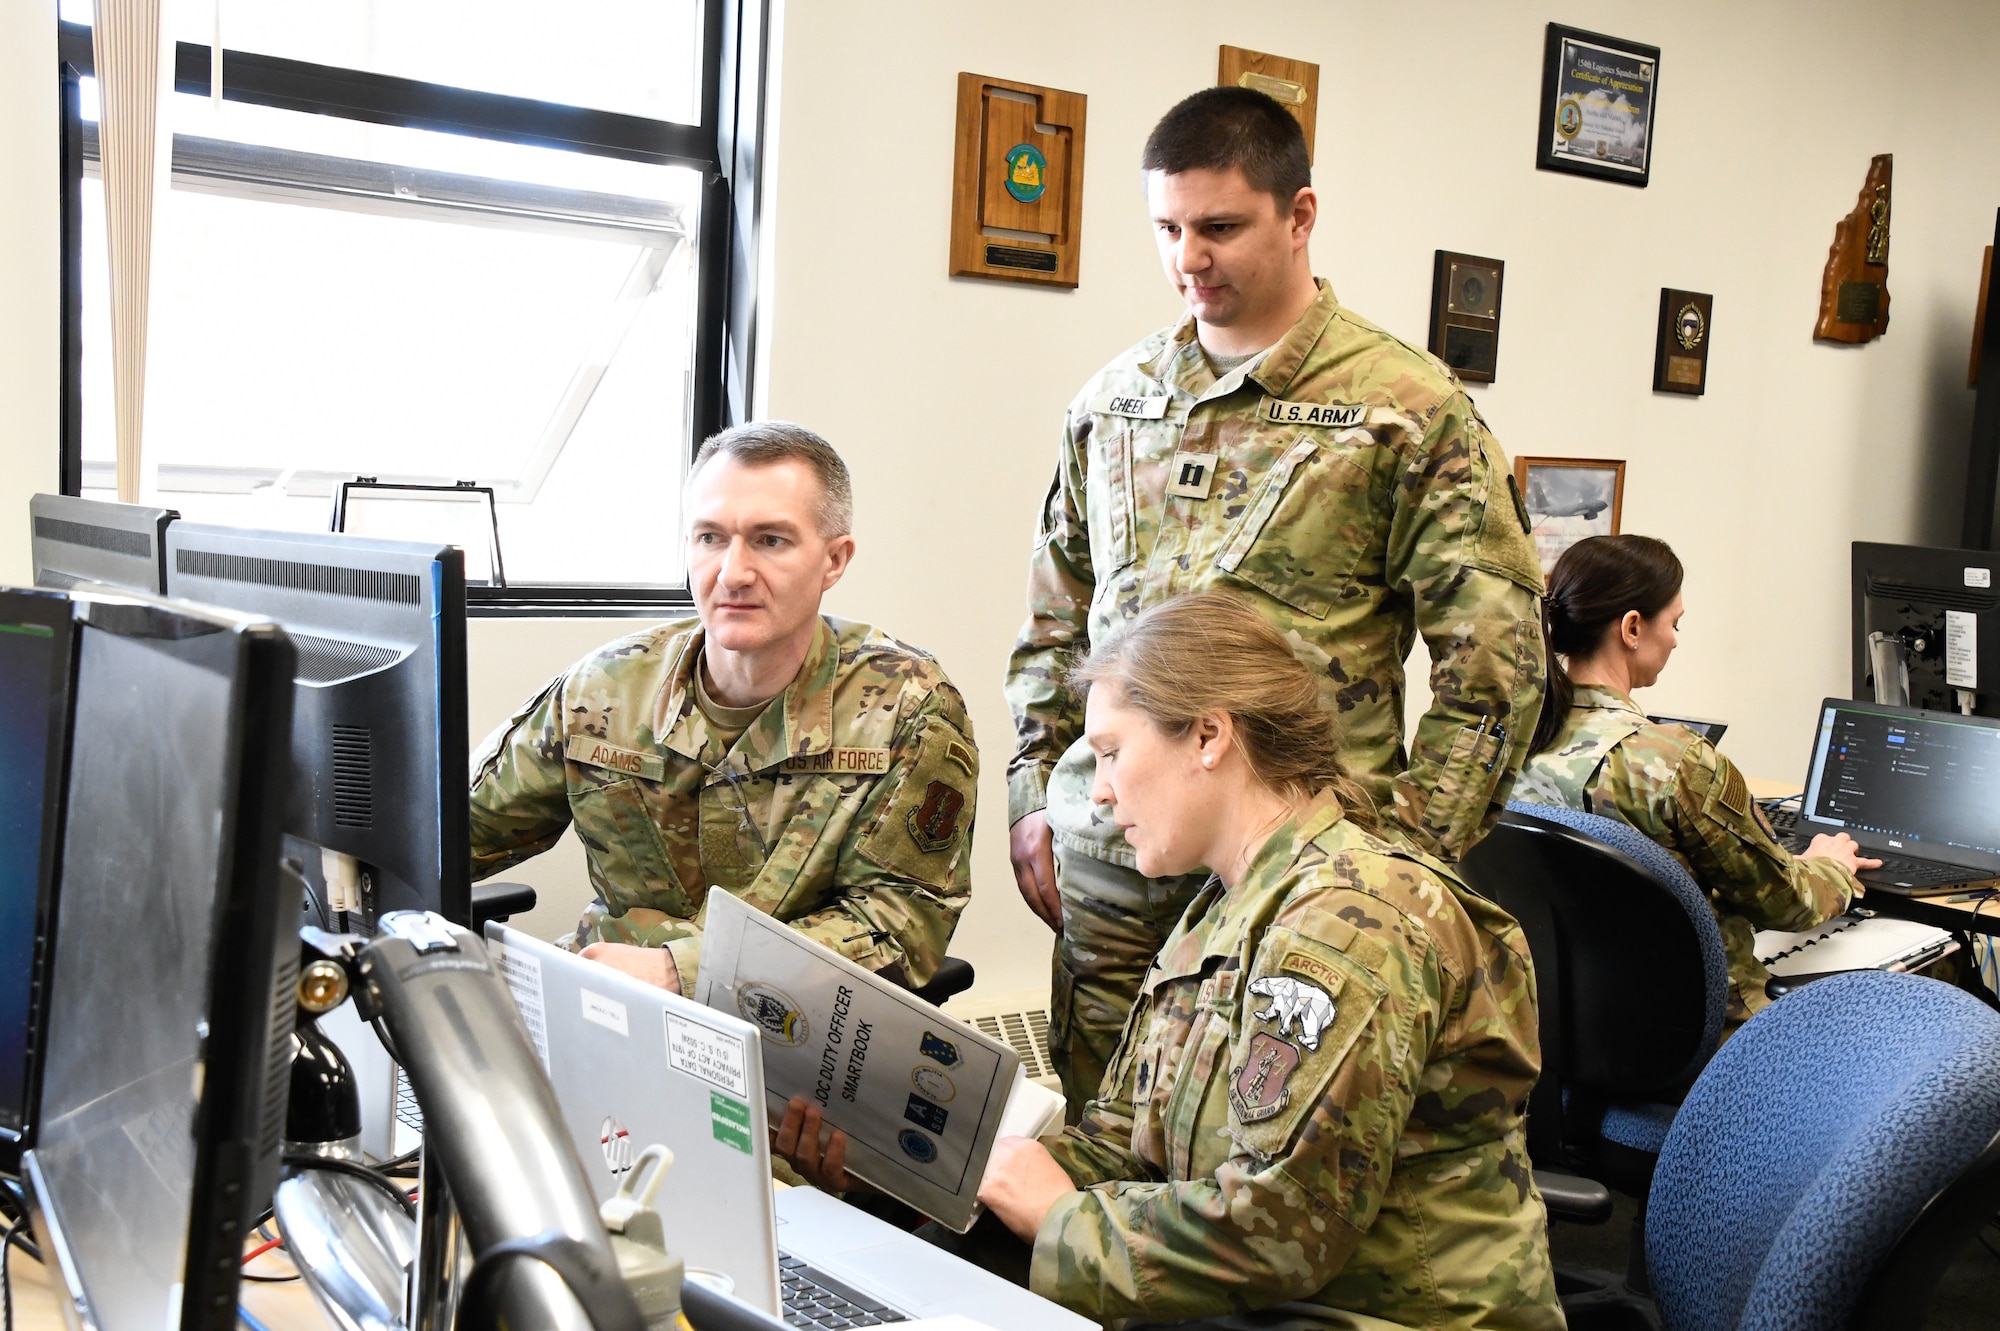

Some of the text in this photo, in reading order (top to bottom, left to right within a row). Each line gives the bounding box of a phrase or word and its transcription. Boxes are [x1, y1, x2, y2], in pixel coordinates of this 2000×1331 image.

[1577, 58, 1639, 79] 154th Logistics Squadron
[1570, 68, 1600, 83] Certificate
[1601, 77, 1608, 85] of
[1609, 78, 1644, 94] Appreciation
[1109, 396, 1148, 415] CHEEK
[1306, 407, 1361, 424] ARMY
[590, 744, 643, 773] ADAMS
[813, 750, 834, 770] AIR
[838, 750, 884, 771] FORCE
[1888, 839, 1903, 849] DELL
[1289, 956, 1340, 986] ARCTIC
[815, 985, 854, 1107] JOC DUTY OFFICER
[672, 1042, 741, 1079] PRIVACY ACT OF 1974
[680, 1057, 735, 1088] PERSONAL DATA
[841, 1018, 874, 1103] SMARTBOOK
[909, 1103, 928, 1119] A
[1256, 1105, 1276, 1118] GUARD
[711, 1112, 751, 1136] UNCLASSIFIED
